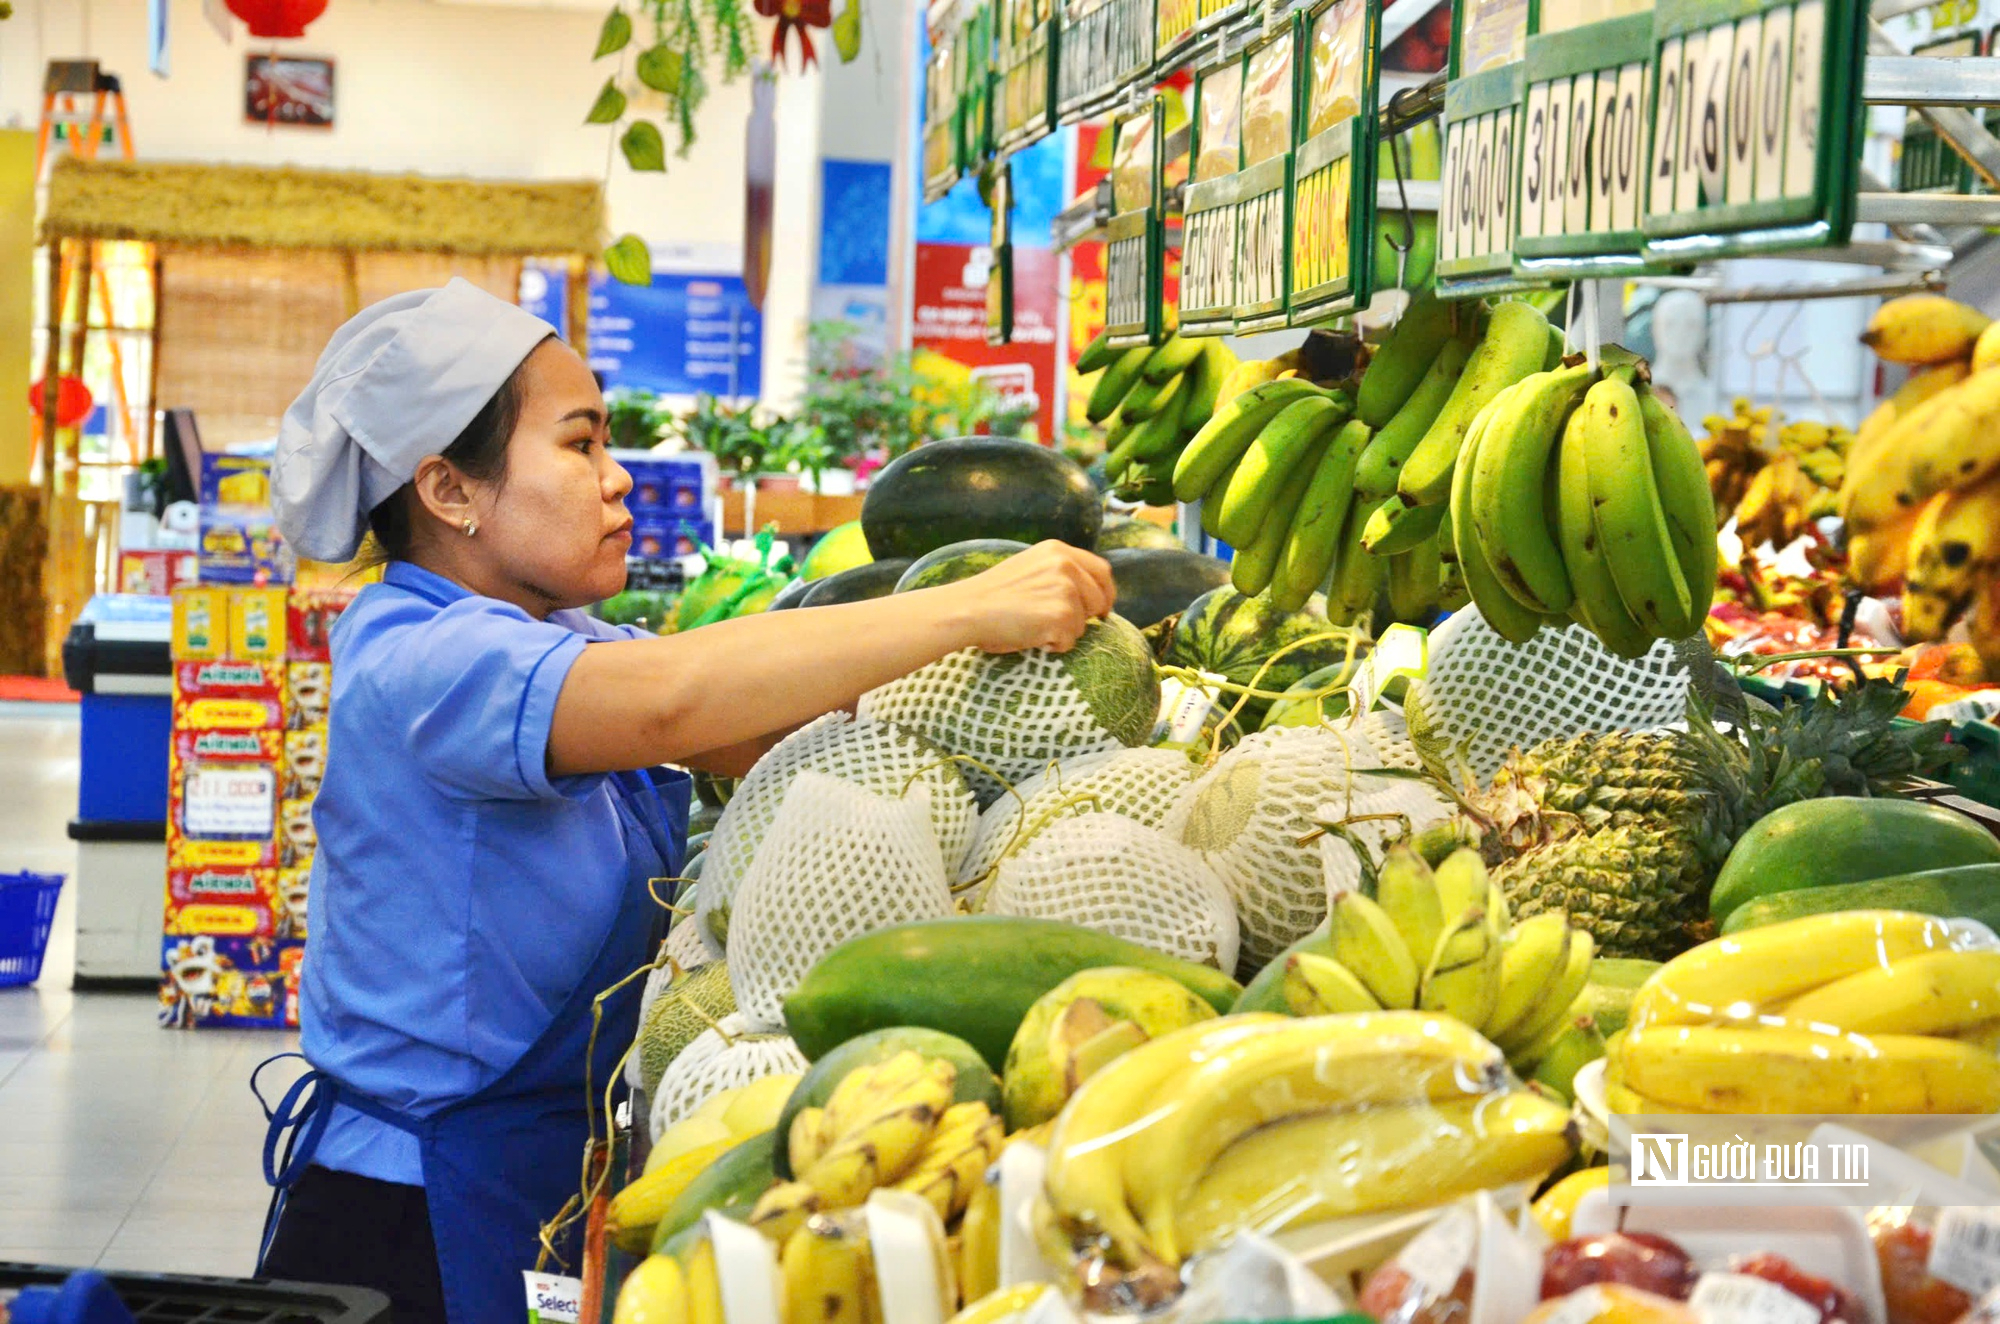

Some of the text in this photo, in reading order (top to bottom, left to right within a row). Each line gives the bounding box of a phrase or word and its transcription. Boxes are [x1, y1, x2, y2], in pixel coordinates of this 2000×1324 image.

[1528, 91, 1633, 203] 31.000
[1659, 38, 1782, 177] 21.600
[537, 1293, 580, 1314] Select
